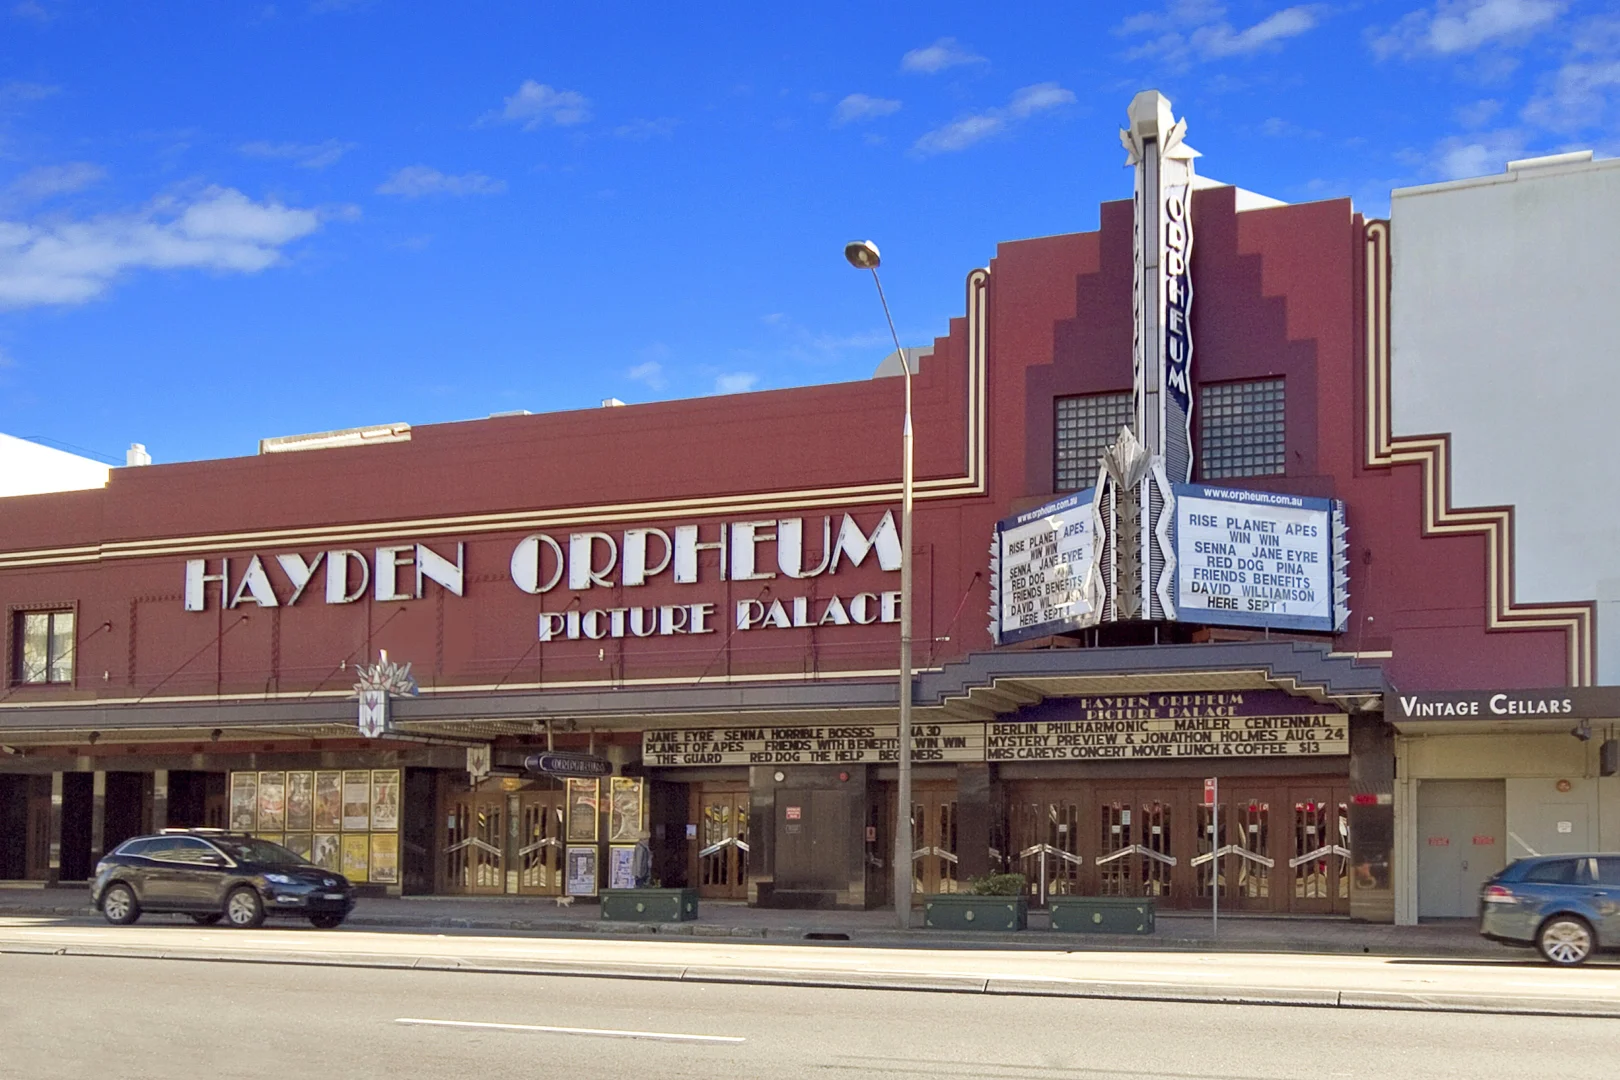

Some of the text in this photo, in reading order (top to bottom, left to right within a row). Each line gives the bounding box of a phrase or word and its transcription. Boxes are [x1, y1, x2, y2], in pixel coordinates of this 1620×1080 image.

[1167, 194, 1186, 394] ORPHEUM
[1204, 488, 1302, 506] www.orpheum.com.au
[1017, 497, 1078, 523] www.orpheum.com.au
[1189, 514, 1317, 537] RISE PLANET APES
[1009, 521, 1084, 555] RISE PLANET APES
[1230, 531, 1279, 546] WIN WIN
[184, 508, 902, 611] HAYDEN ORPHEUM
[1031, 542, 1058, 560] WIN WIN
[1195, 541, 1318, 563] SENNA JANE EYRE
[1010, 548, 1083, 579] SENNA JANE EYRE
[1207, 556, 1304, 575] RED DOG PINA
[1012, 579, 1026, 591] RED
[1029, 572, 1045, 586] DOG
[1193, 568, 1310, 589] FRIENDS BENEFITS
[1013, 575, 1083, 603] FRIENDS BENEFITS
[1191, 582, 1314, 601] DAVID WILLIAMSON
[1011, 601, 1034, 616] DAVID
[1208, 596, 1287, 612] HERE SEPT 1
[539, 591, 901, 642] PICTURE PALACE
[1019, 612, 1038, 627] HERE
[1043, 607, 1063, 621] SEPT
[1081, 694, 1243, 709] HAYDEN ORPHEUM
[1087, 706, 1237, 720] PICTURE PALACE
[648, 732, 678, 742] JANE
[684, 731, 714, 742] EYRE
[724, 730, 765, 741] SENNA
[771, 728, 824, 740] HORRIBLE
[829, 727, 875, 738] BOSSES
[927, 726, 941, 737] 3D
[993, 716, 1330, 735] BERLIN PHILHARMONIC MAHLER CENTENNIAL
[646, 742, 692, 753] PLANET
[693, 742, 704, 753] OF
[712, 742, 744, 752] APES
[765, 741, 811, 751] FRIENDS
[817, 739, 843, 750] WITH
[915, 738, 938, 748] WIN
[943, 737, 966, 748] WIN
[988, 728, 1344, 747] MYSTERY PREVIEW & JONATHON HOLMES AUG 24
[656, 754, 677, 764] THE
[684, 753, 722, 764] GUARD
[750, 752, 772, 763] RED
[776, 752, 800, 762] DOG
[809, 751, 829, 762] THE
[835, 750, 864, 761] HELP
[988, 742, 1320, 760] MRS CAREYS CONCERT MOVIE LUNCH & COFFEE $13
